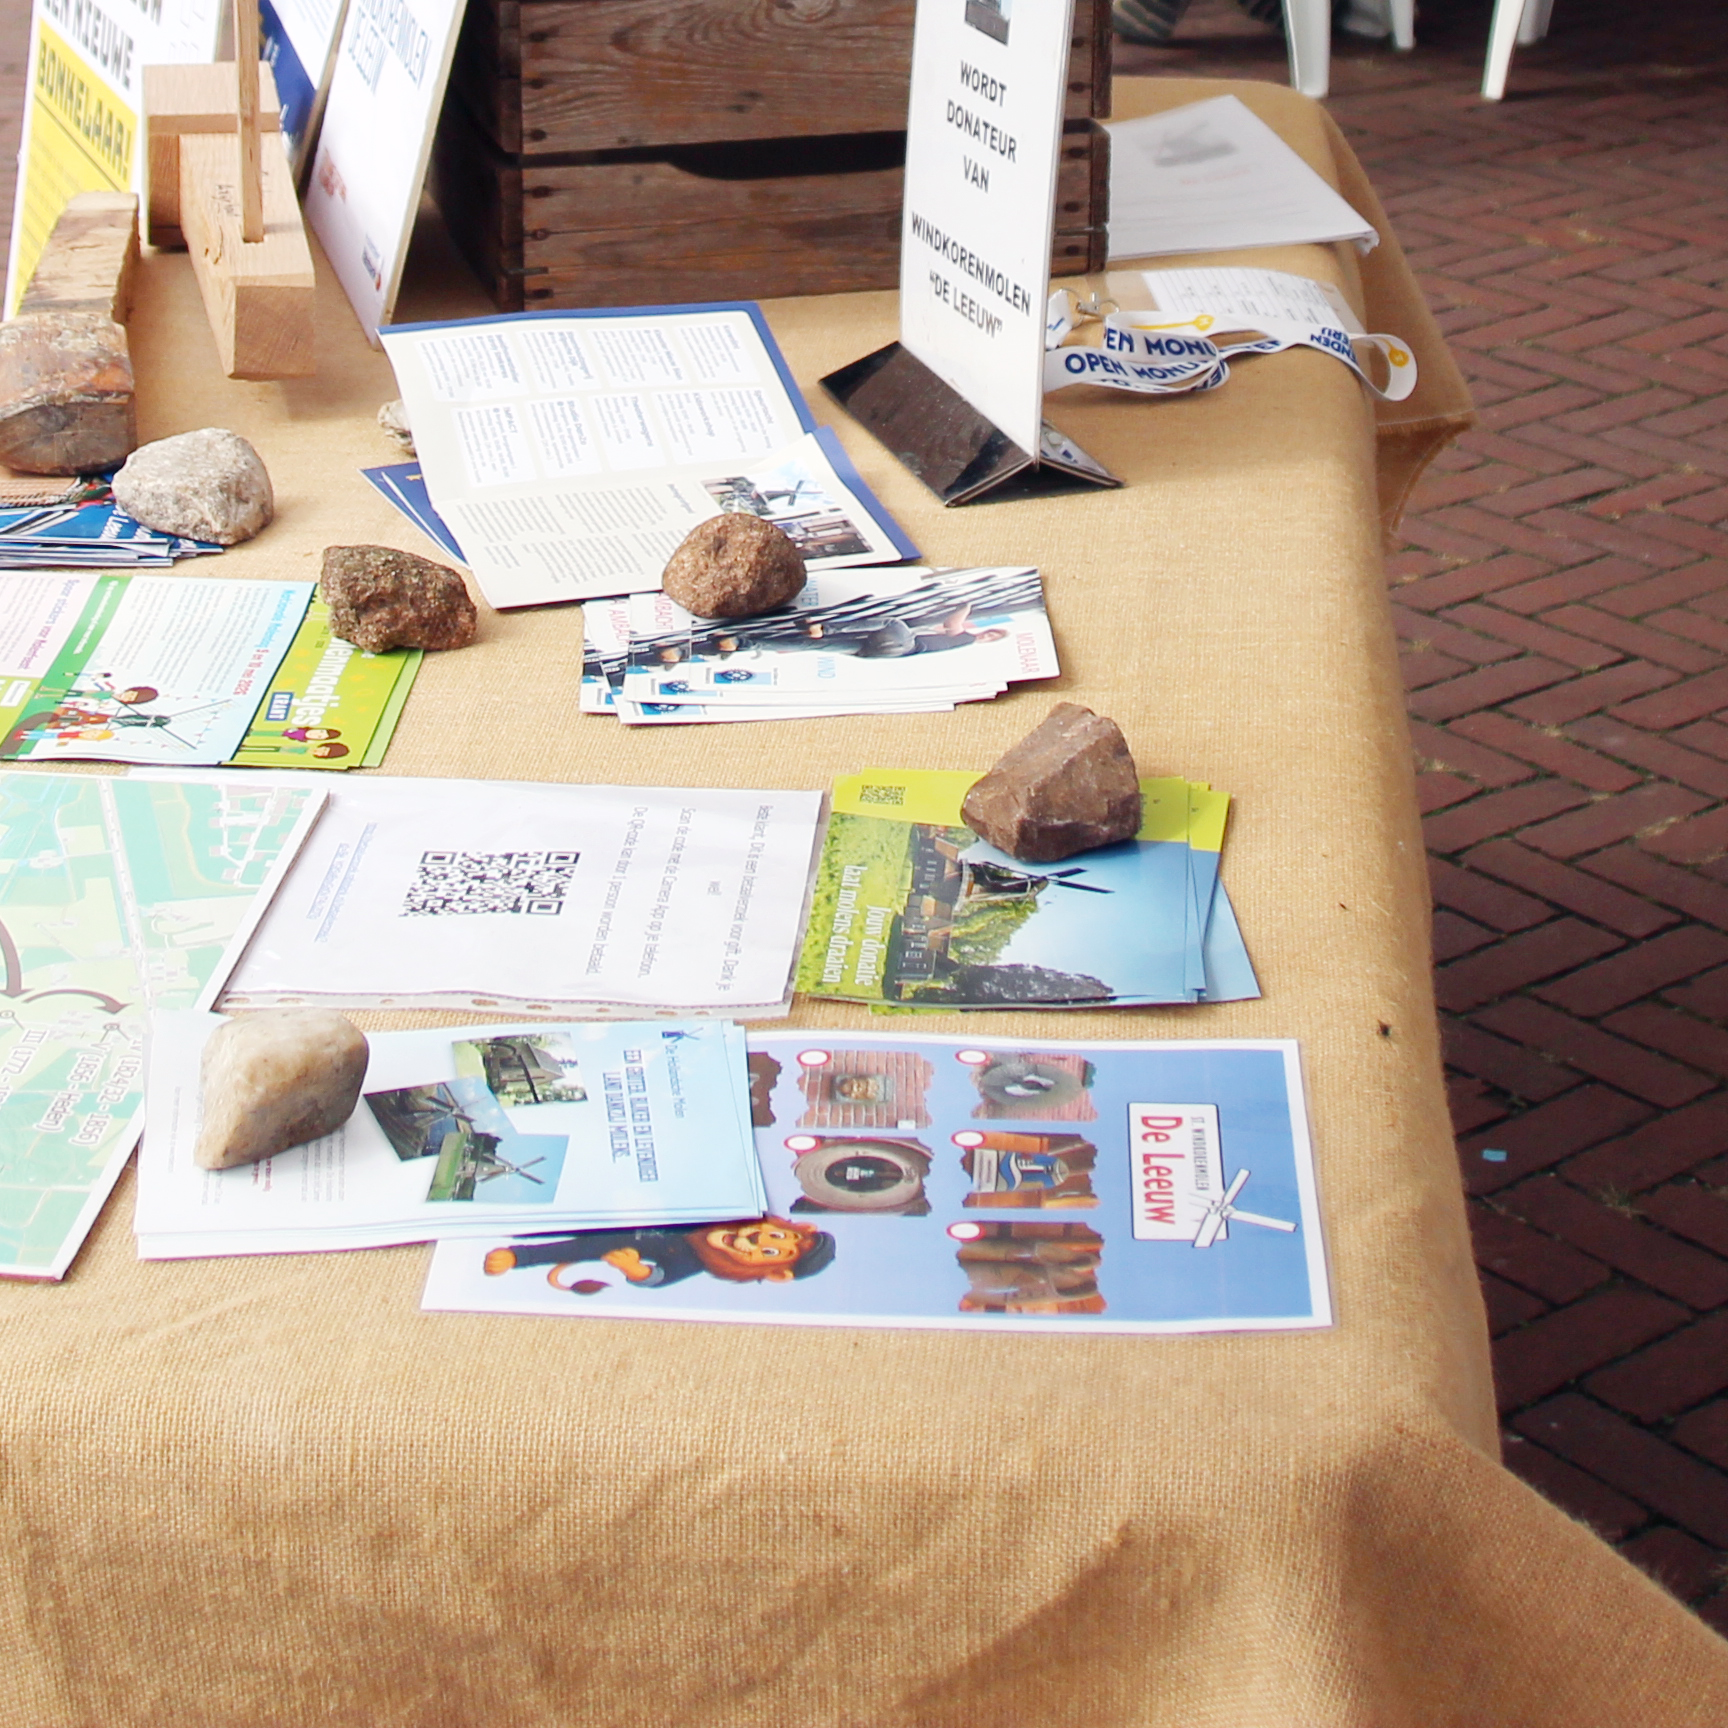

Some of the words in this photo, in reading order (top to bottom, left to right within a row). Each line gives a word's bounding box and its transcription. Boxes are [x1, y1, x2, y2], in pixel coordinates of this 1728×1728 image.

[960, 60, 1007, 107] WORDT
[37, 37, 132, 181] BONKELAAR!
[947, 99, 1016, 163] DONATEUR
[963, 155, 989, 193] VAN
[912, 211, 1031, 317] WINDKORENMOLEN
[1104, 327, 1135, 353] EN
[1065, 353, 1128, 377] OPEN
[504, 407, 518, 434] IMPACT
[46, 599, 68, 625] stickers
[269, 589, 296, 622] Nationale
[1015, 632, 1040, 675] MOLENAAR
[241, 669, 258, 679] mei
[817, 656, 835, 679] WIND
[290, 637, 357, 726] lenmaatjes
[268, 694, 290, 719] KRANT
[632, 806, 648, 818] De
[679, 807, 696, 824] Scan
[623, 819, 645, 847] QR-code
[676, 826, 692, 835] de
[620, 848, 636, 858] kan
[672, 836, 688, 852] code
[615, 860, 631, 874] door
[664, 865, 681, 874] de
[745, 860, 759, 874] een
[841, 865, 868, 887] laat
[603, 881, 624, 909] persoon
[657, 876, 677, 902] Camera
[734, 875, 757, 922] betaalverzoek
[649, 904, 669, 919] App
[831, 889, 860, 934] molens
[865, 905, 891, 935] Jouw
[595, 911, 614, 941] worden
[644, 931, 662, 941] je
[648, 920, 660, 931] op
[730, 923, 745, 940] voor
[585, 943, 608, 975] betaald.
[638, 943, 659, 978] telefoon.
[720, 959, 740, 980] Dank
[821, 935, 854, 983] draaien
[854, 939, 885, 986] donatie
[716, 982, 734, 991] je
[23, 1029, 47, 1044] III
[91, 1043, 110, 1051] V
[1, 1045, 36, 1075] (1772
[665, 1045, 678, 1055] De
[66, 1051, 105, 1083] (1856
[99, 1054, 142, 1103] (1824/32
[667, 1056, 683, 1096] Hollandsche
[34, 1092, 81, 1132] Heden)
[673, 1098, 687, 1119] Molen
[1190, 1116, 1206, 1126] ST.
[71, 1113, 110, 1146] 1856)
[633, 1125, 653, 1136] EN
[1141, 1116, 1183, 1143] De
[1192, 1129, 1210, 1191] WINDKORENMOLEN
[1142, 1153, 1185, 1225] Leeuw
